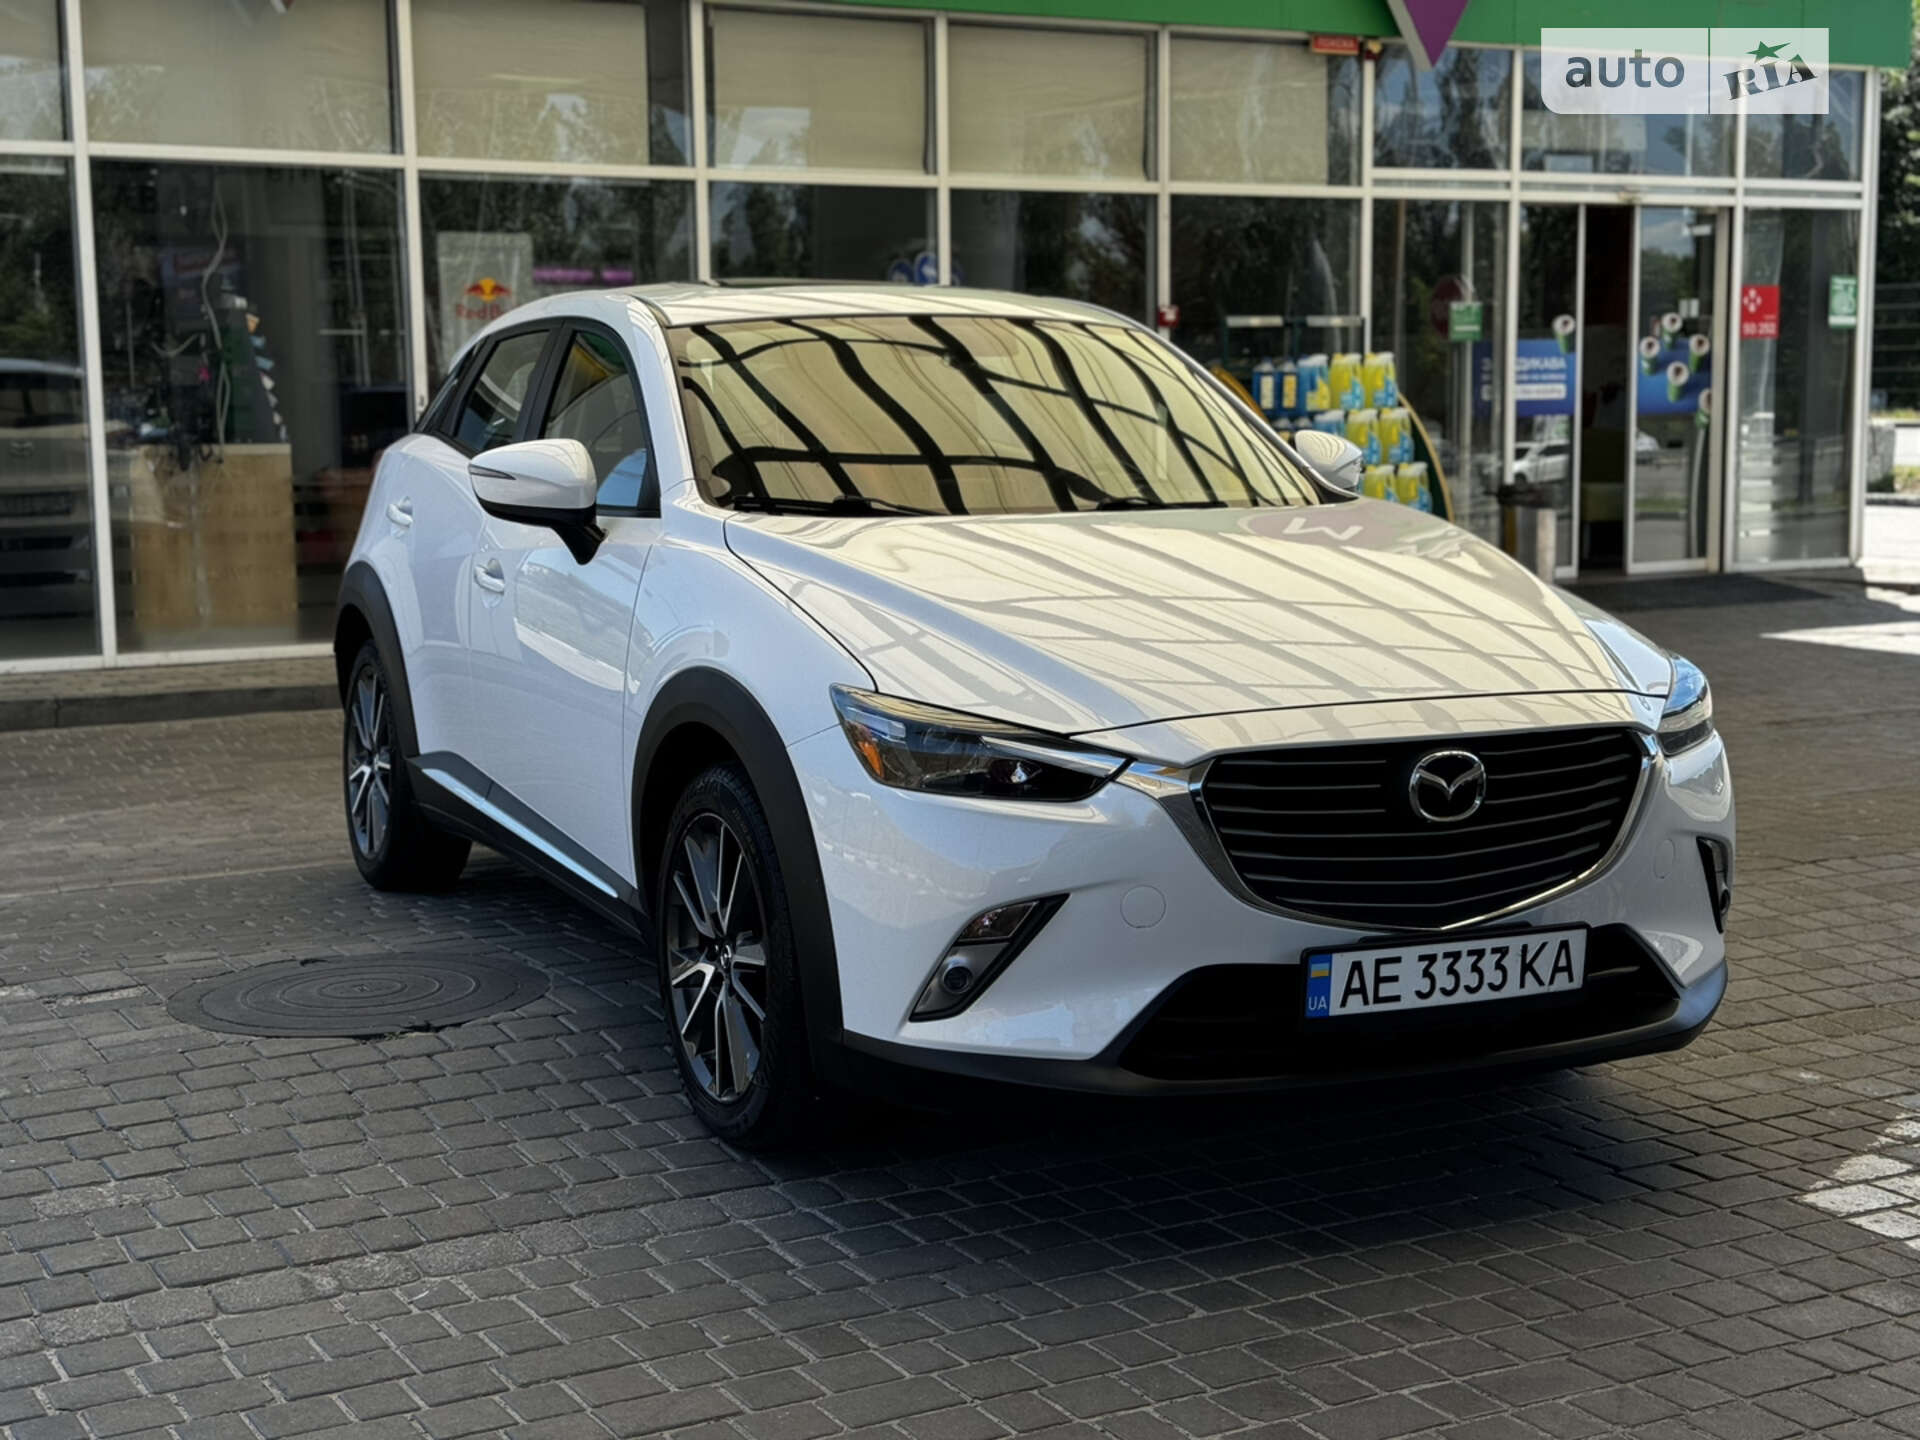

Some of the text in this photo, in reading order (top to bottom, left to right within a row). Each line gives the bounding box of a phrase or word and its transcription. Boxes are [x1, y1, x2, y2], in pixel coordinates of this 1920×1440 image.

[1339, 939, 1576, 1009] AE 3333 KA
[1308, 996, 1328, 1010] UA
